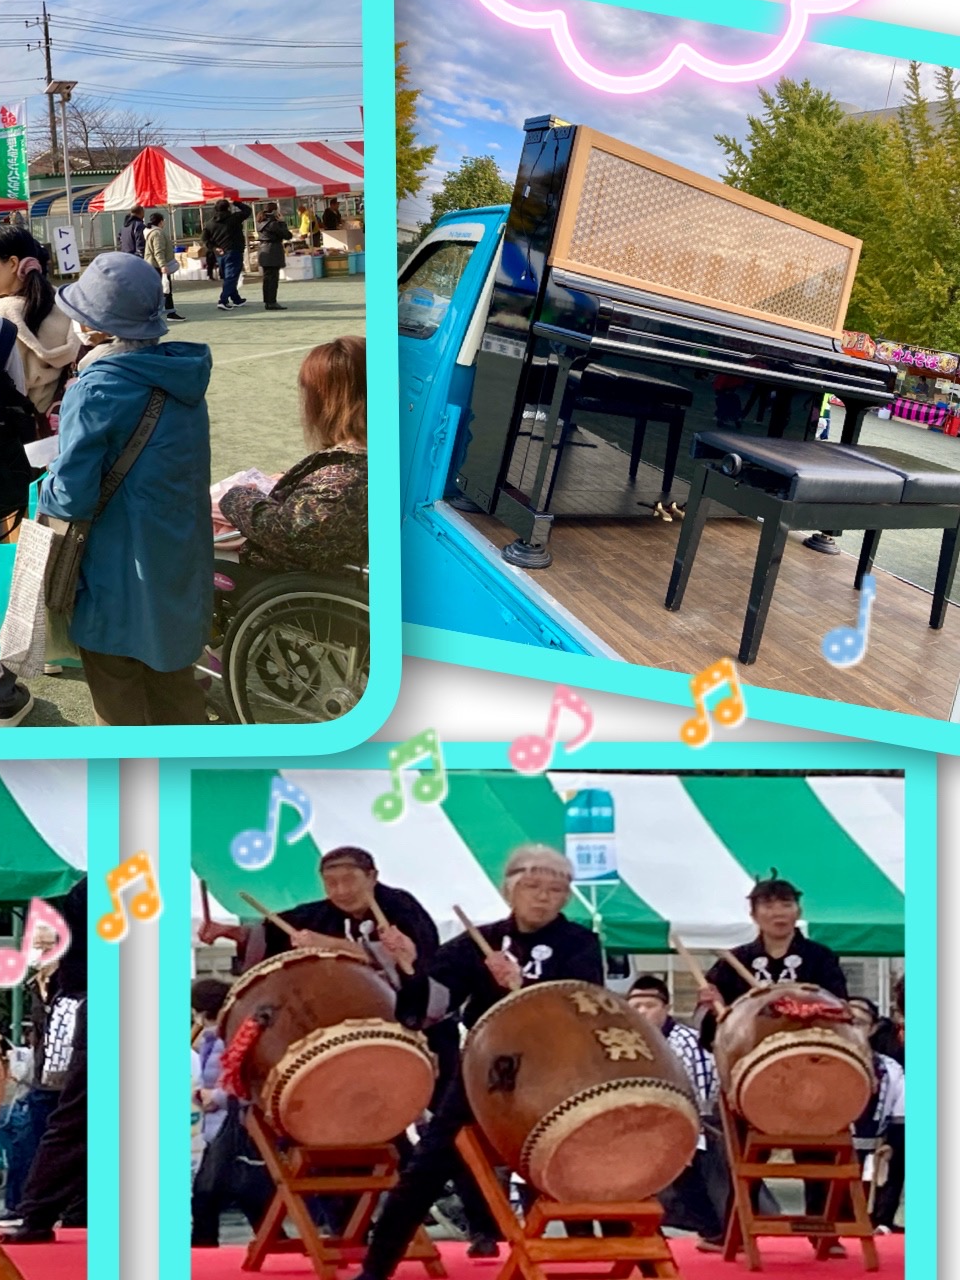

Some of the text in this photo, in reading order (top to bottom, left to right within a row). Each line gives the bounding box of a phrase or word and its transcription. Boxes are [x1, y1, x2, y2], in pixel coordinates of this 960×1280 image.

[58, 228, 76, 272] トイレ
[892, 348, 940, 370] オムそば
